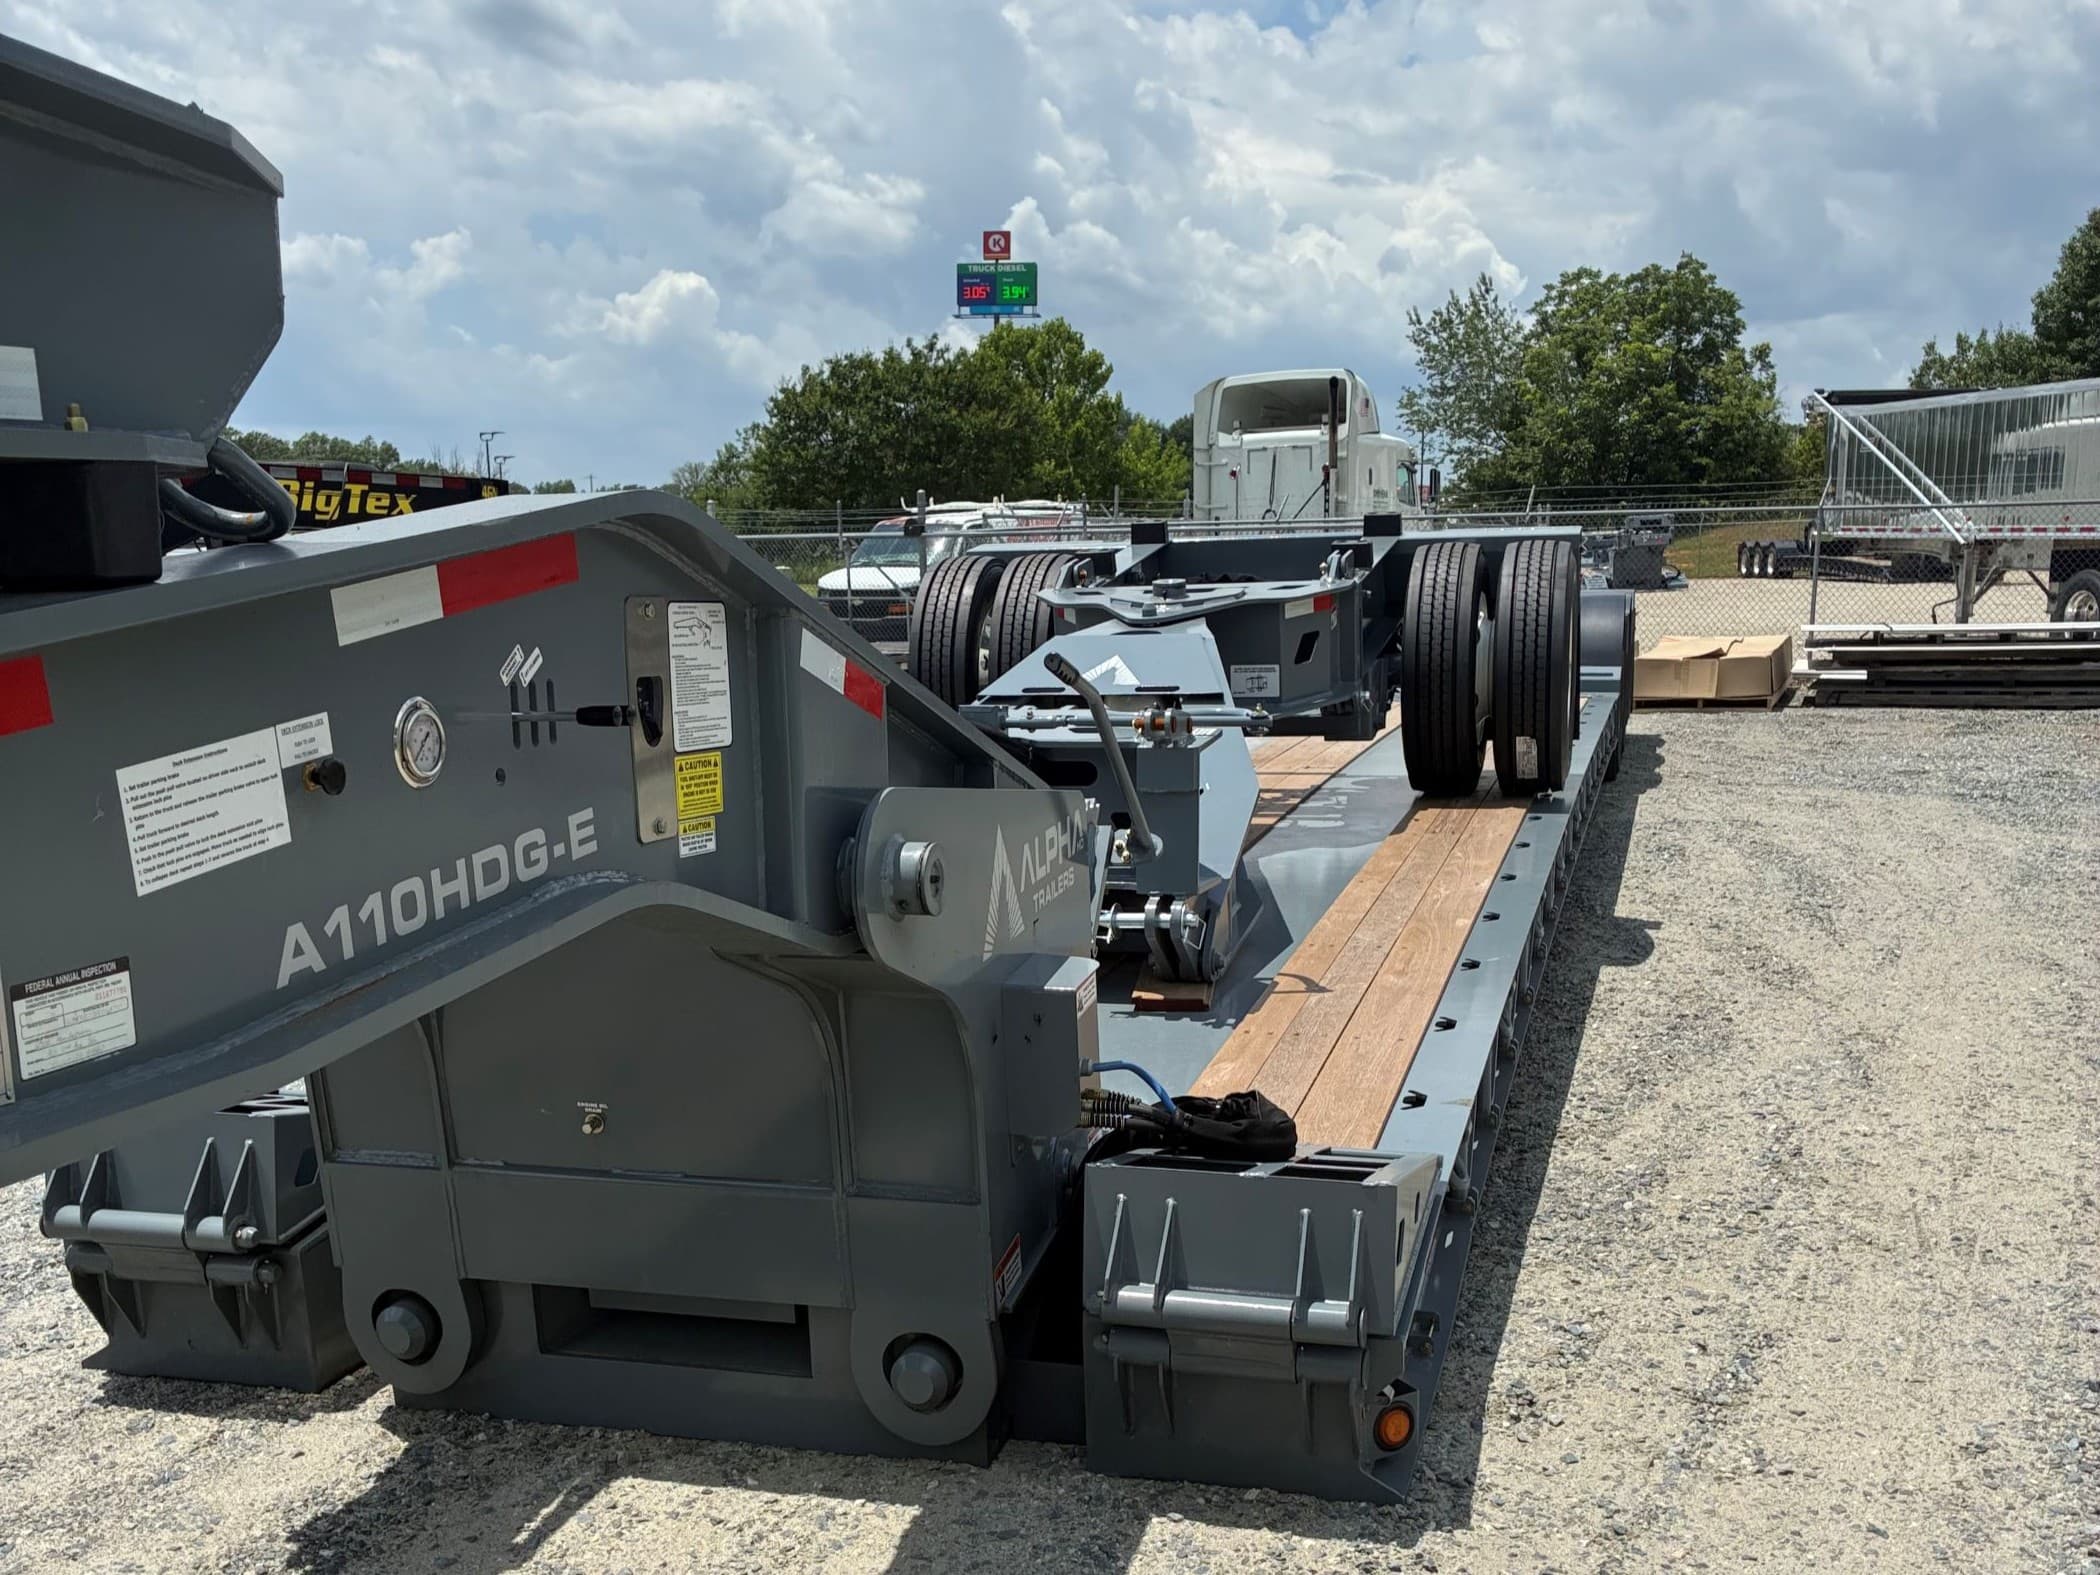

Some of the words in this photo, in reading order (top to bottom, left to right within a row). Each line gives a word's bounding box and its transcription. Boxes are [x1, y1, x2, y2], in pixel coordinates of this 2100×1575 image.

[997, 264, 1026, 272] DIESEL
[684, 758, 711, 771] CAUTION
[1020, 809, 1083, 893] ALPHA
[276, 807, 598, 989] A110HDG-E
[1033, 867, 1075, 912] TRAILERS
[25, 978, 54, 993] FEDERAL
[55, 971, 80, 986] ANNUAL
[81, 961, 117, 979] INSPECTION
